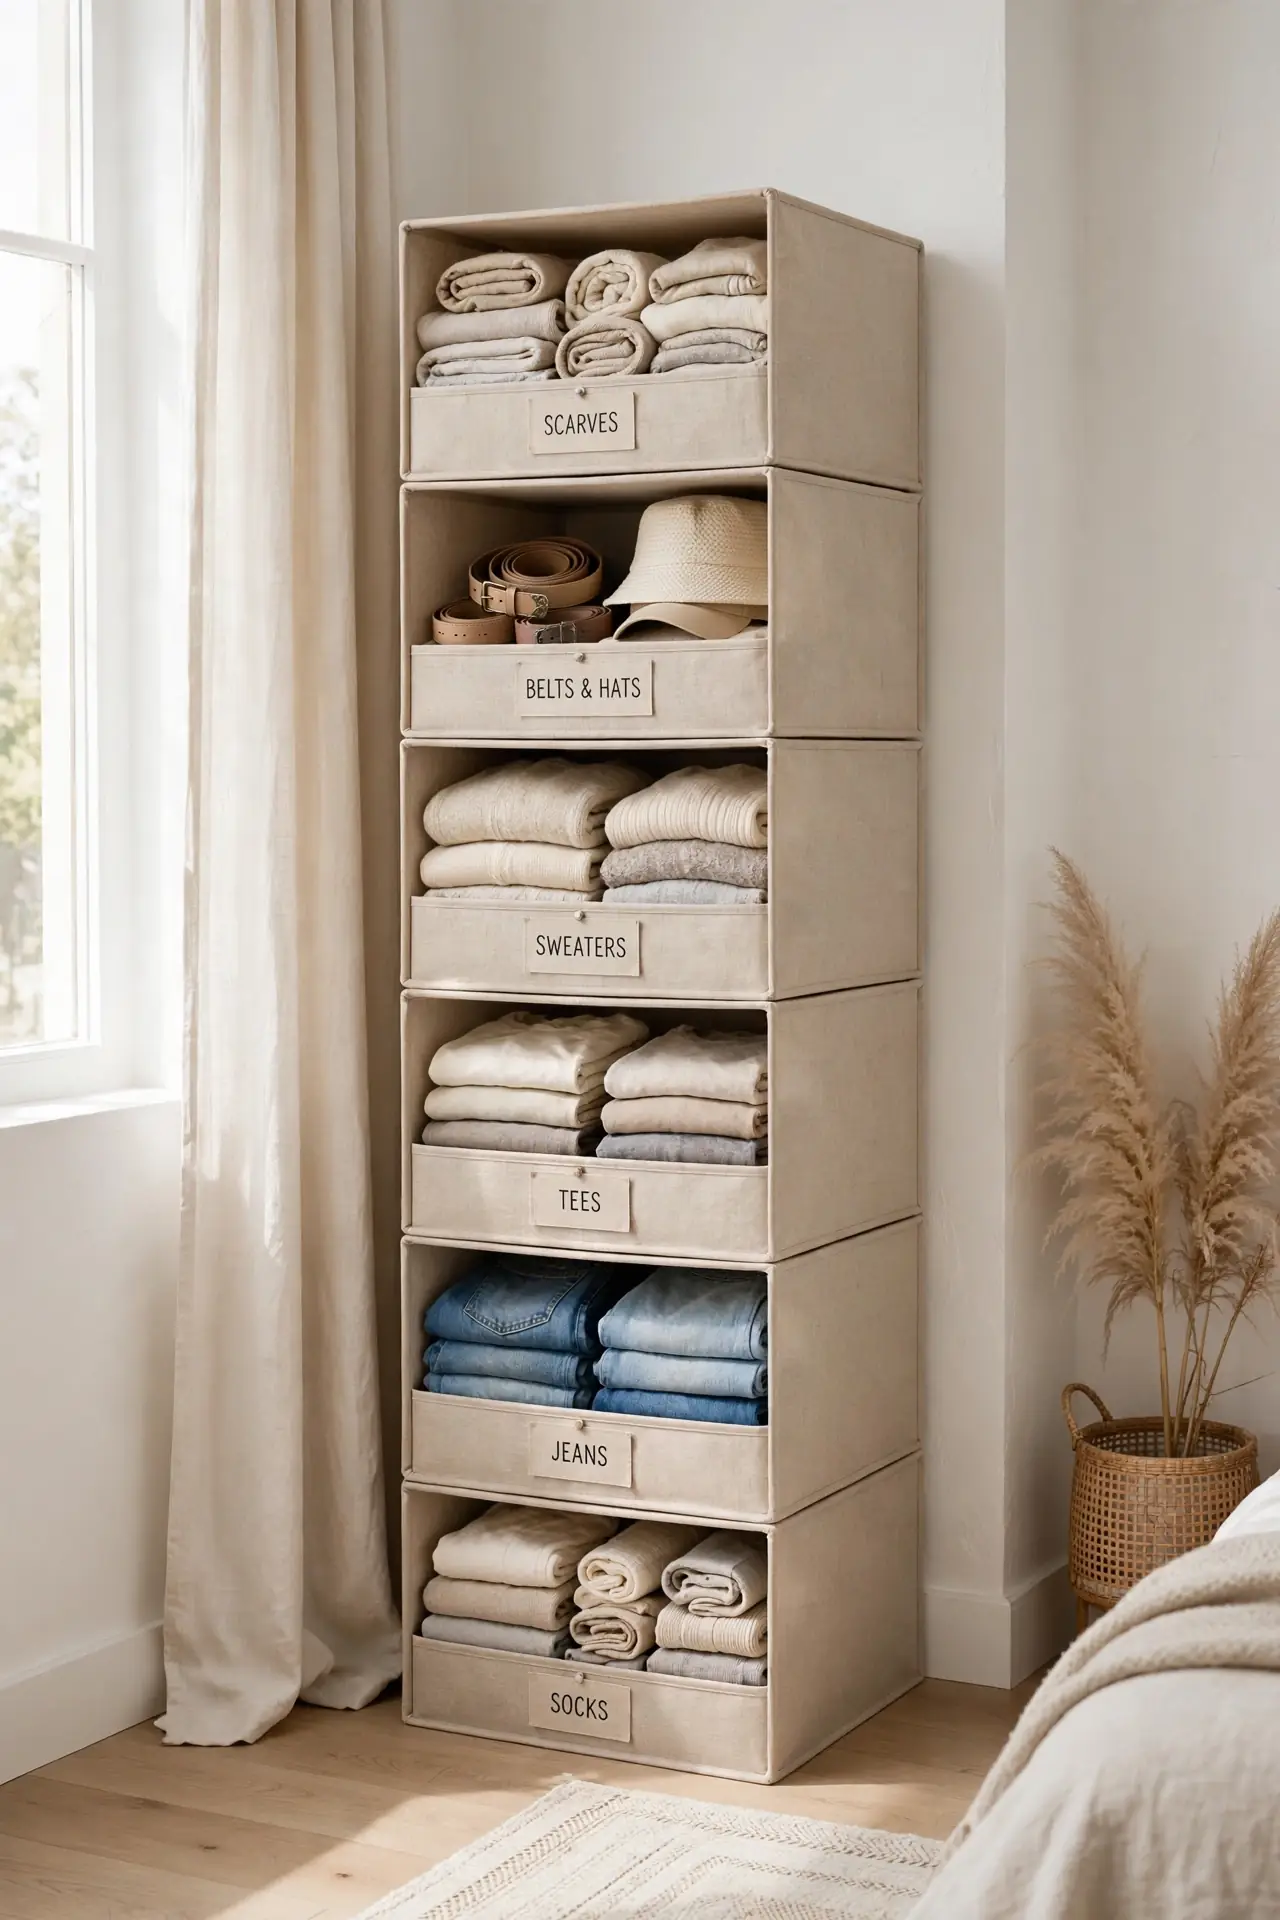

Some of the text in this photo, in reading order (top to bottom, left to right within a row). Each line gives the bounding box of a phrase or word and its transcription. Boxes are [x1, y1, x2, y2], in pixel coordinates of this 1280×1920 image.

[544, 411, 619, 436] SCARVES
[526, 677, 641, 700] BELTS & HATS
[535, 934, 627, 959] SWEATERS
[558, 1189, 601, 1213] TEES
[551, 1440, 608, 1467] JEANS
[550, 1692, 609, 1721] SOCKS
